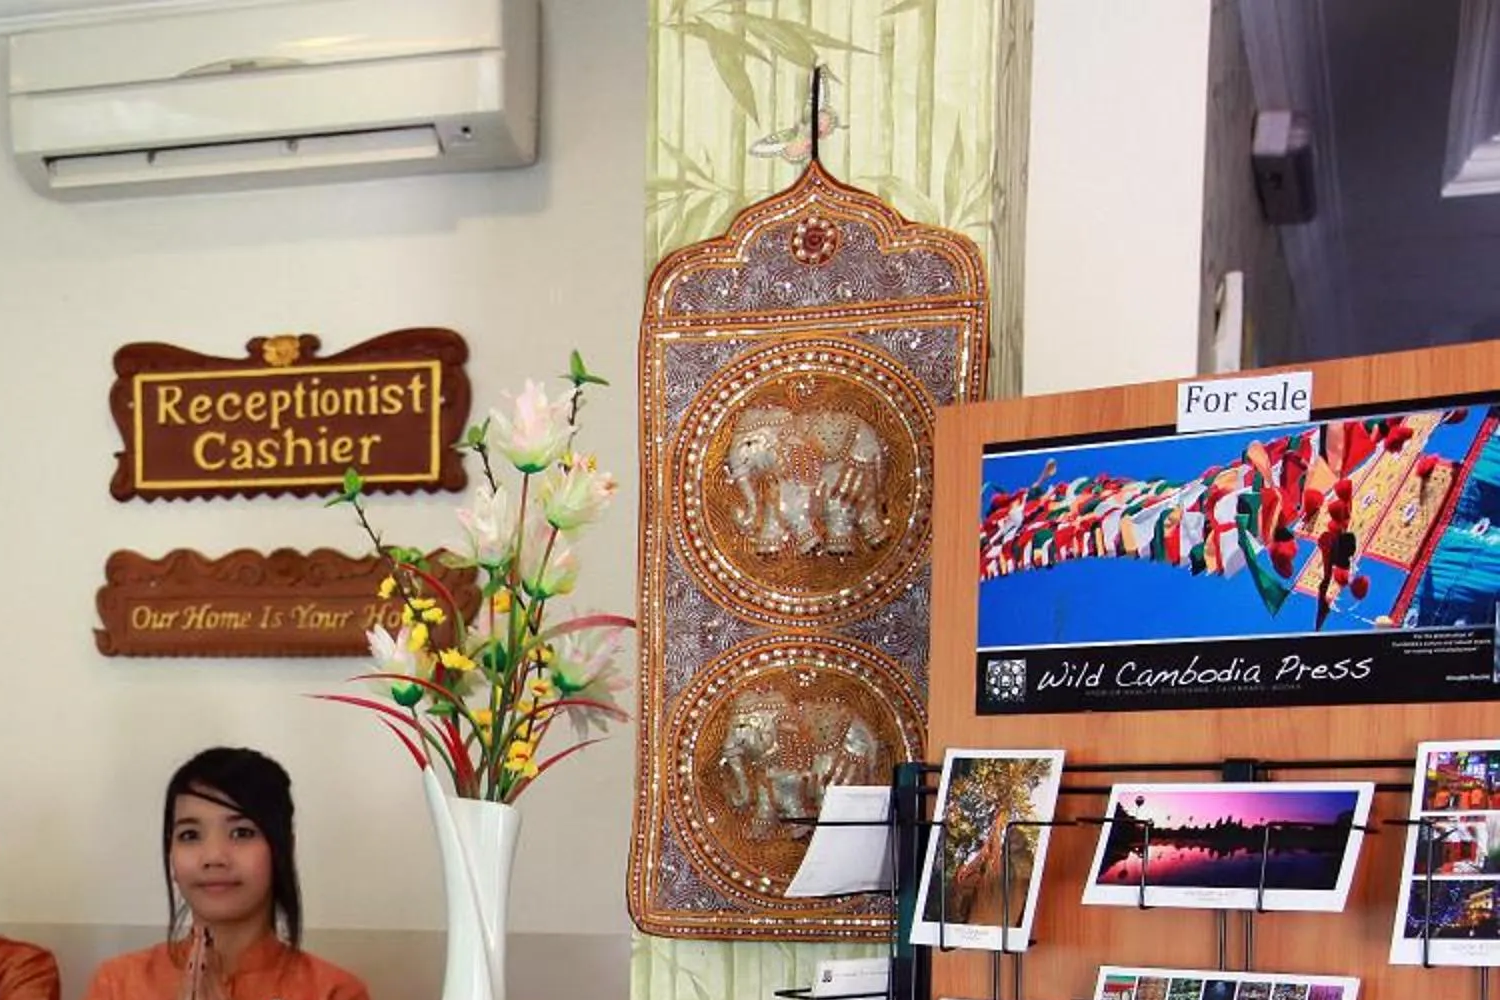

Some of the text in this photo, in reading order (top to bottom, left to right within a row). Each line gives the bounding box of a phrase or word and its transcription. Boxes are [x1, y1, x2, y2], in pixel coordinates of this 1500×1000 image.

[156, 373, 426, 430] Receptionist
[1185, 381, 1308, 414] For sale
[192, 426, 381, 470] Cashier
[131, 605, 181, 630] Our
[182, 603, 253, 630] Home
[259, 605, 284, 630] Is
[289, 602, 355, 630] Your
[1036, 660, 1103, 691] Wild
[1115, 654, 1262, 688] Cambodia
[1274, 654, 1374, 682] Press
